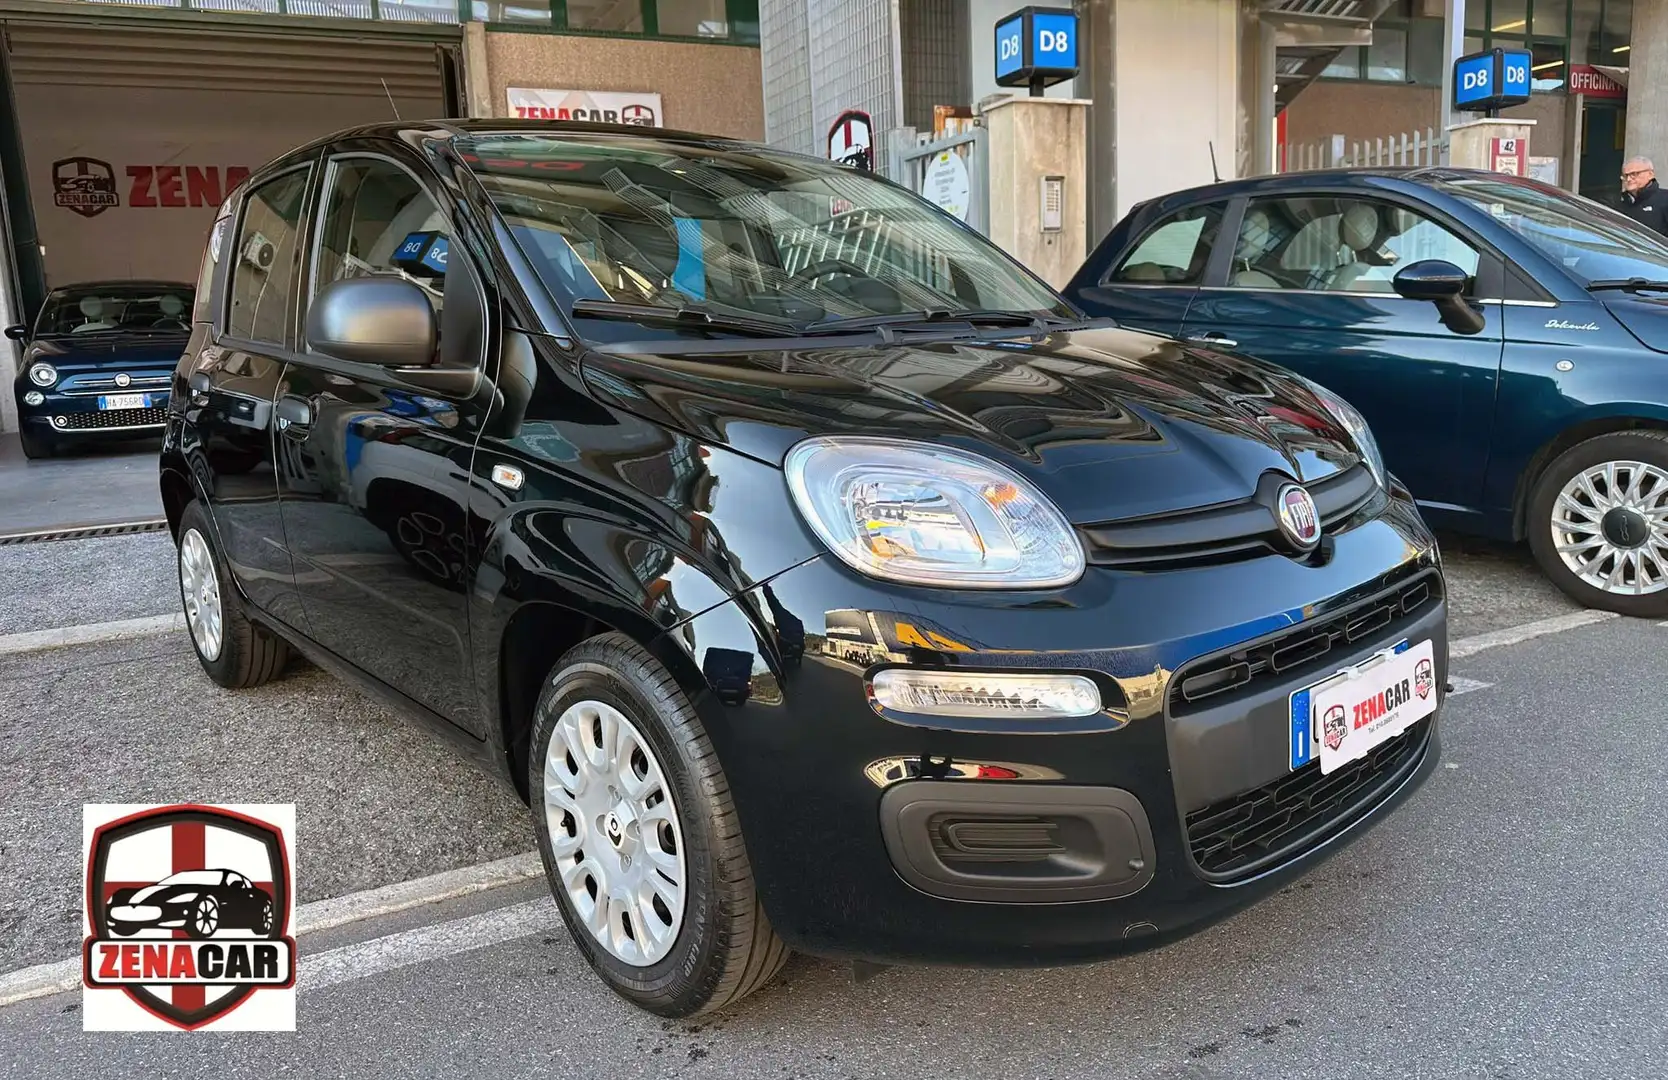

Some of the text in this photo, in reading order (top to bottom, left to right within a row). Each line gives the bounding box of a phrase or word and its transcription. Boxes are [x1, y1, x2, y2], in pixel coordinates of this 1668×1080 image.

[1001, 34, 1019, 60] D8
[1040, 30, 1068, 52] D8
[1464, 69, 1488, 90] D8
[1507, 66, 1525, 83] D8
[59, 193, 115, 205] ZENACAR
[1289, 502, 1314, 530] FIAT
[1353, 679, 1411, 730] ZENACAR
